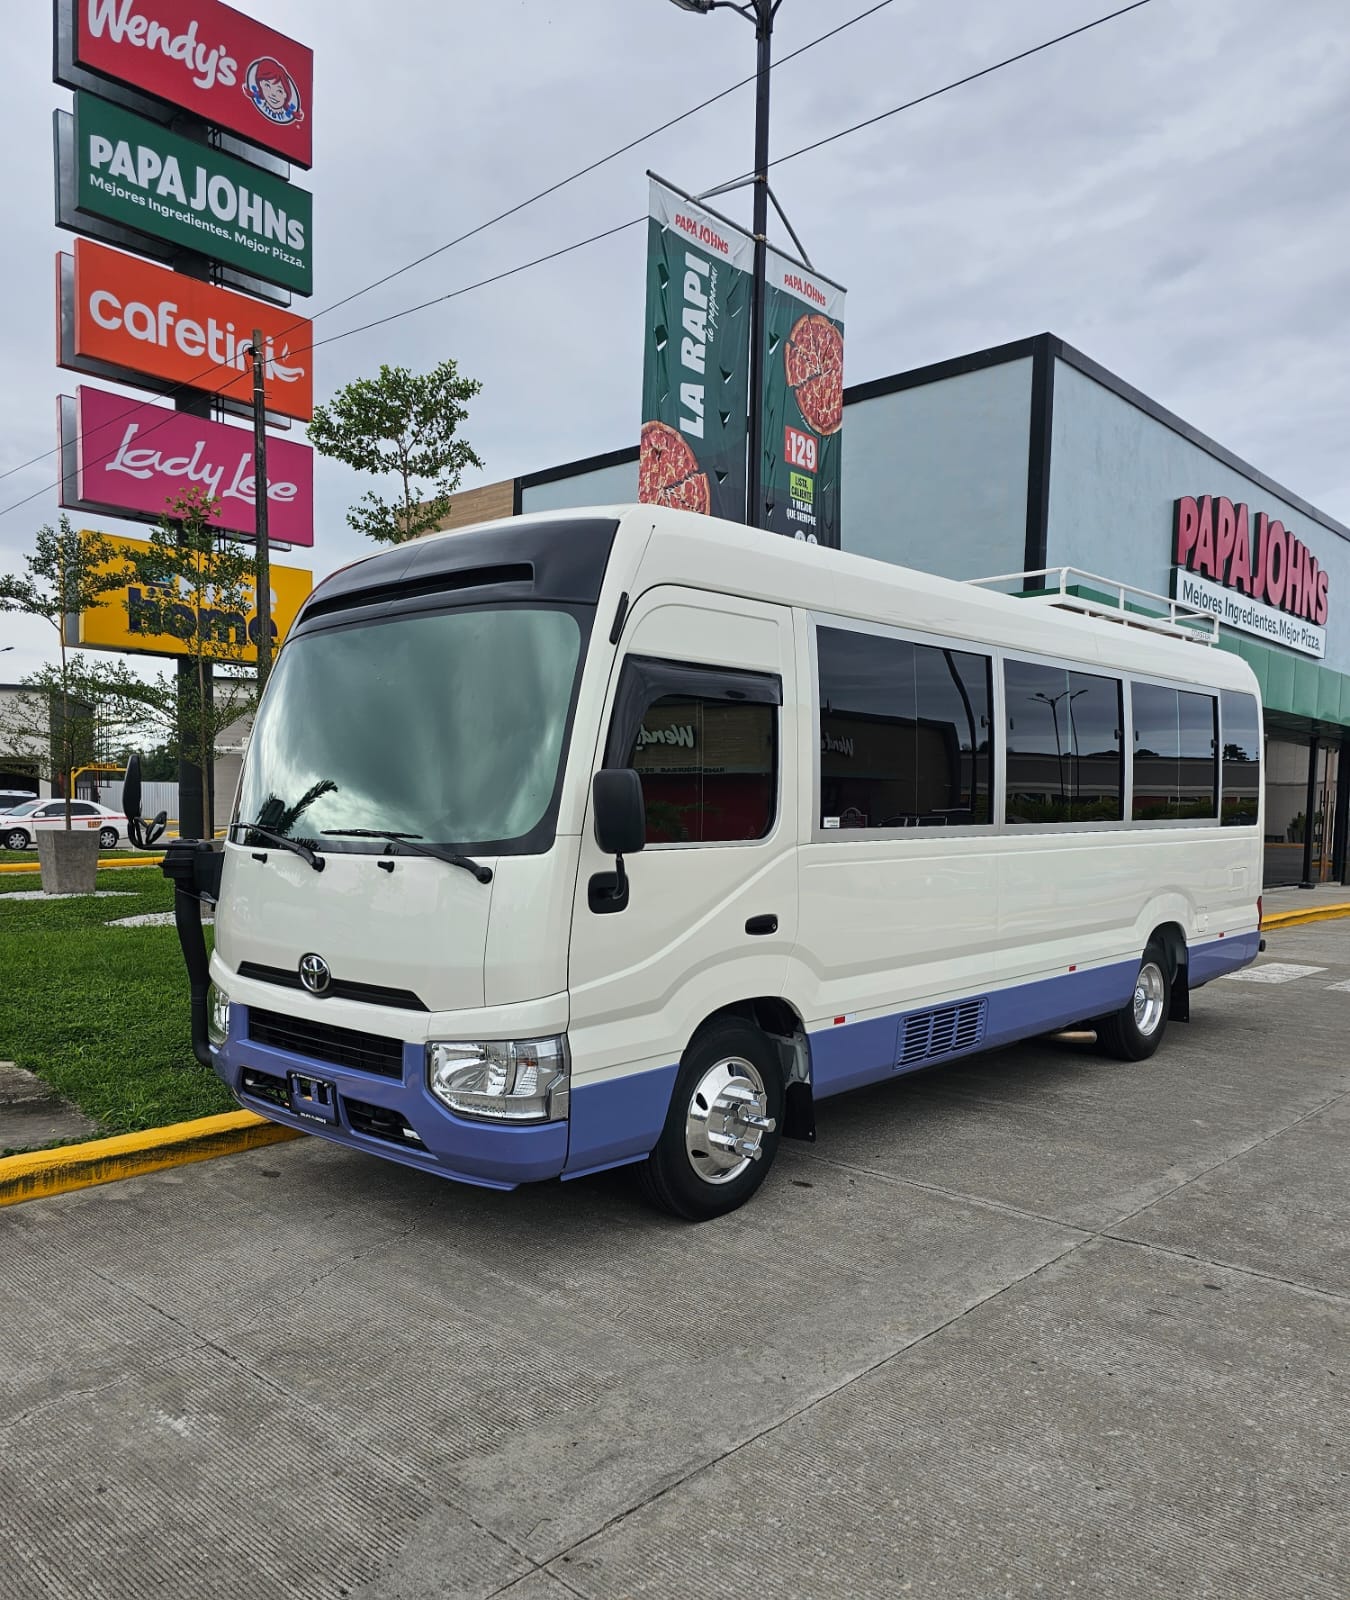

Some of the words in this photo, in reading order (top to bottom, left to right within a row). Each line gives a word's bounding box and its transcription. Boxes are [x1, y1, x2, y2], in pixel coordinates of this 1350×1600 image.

[88, 0, 237, 89] Wendy's
[89, 134, 187, 205] PAPA
[191, 165, 305, 250] JOHNS
[90, 173, 145, 206] Mejores
[148, 197, 232, 240] Ingredientes.
[234, 231, 273, 256] Mejor
[273, 248, 305, 269] Pizza.
[675, 214, 697, 238] PAPA
[698, 225, 729, 254] JOHNS
[681, 251, 710, 375] RAPI
[784, 274, 803, 291] PAPA
[803, 282, 826, 306] JOHNS
[680, 382, 705, 439] LA
[105, 423, 224, 502] Lady
[222, 452, 298, 505] Lee
[1172, 495, 1251, 594] PAPA
[1253, 511, 1328, 625] JOHNS
[1183, 580, 1222, 615] Mejores
[1225, 596, 1278, 635] Ingredientes.
[1279, 619, 1300, 645] Mejor
[1301, 628, 1320, 651] Pizza.
